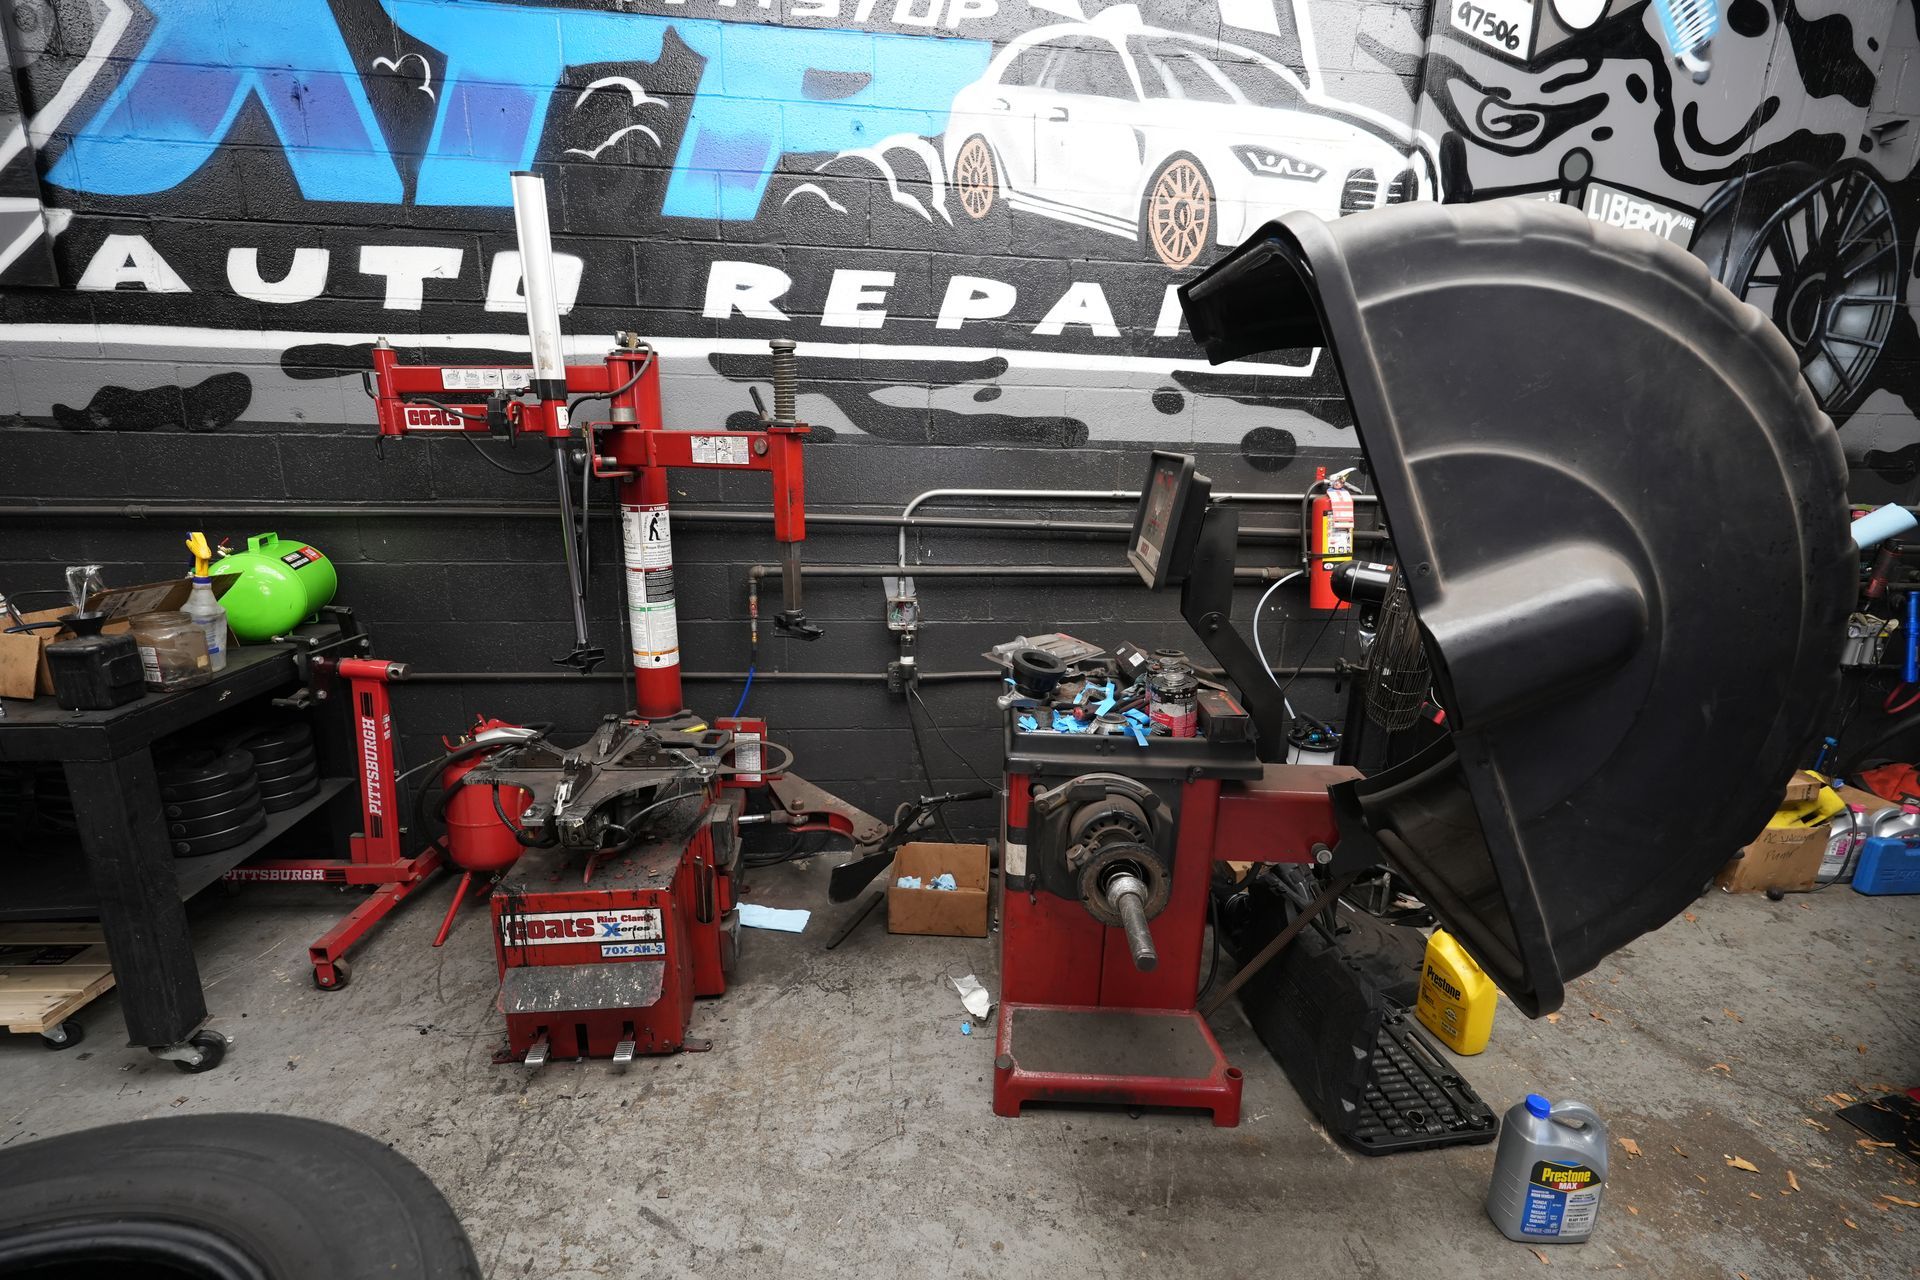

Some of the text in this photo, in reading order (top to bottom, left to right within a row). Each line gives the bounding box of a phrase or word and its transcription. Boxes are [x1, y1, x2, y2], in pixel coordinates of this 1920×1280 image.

[1457, 1, 1520, 51] 97506
[1587, 188, 1696, 241] LIBERTY AVE
[76, 234, 1182, 337] AUTO REPAI
[361, 716, 382, 816] PITTSBURGH
[596, 914, 653, 924] Rim Clamp
[603, 944, 663, 956] 70X-AH-3
[1427, 964, 1461, 1001] Prestone
[1541, 1167, 1591, 1183] Prestone
[1558, 1182, 1577, 1190] MAX
